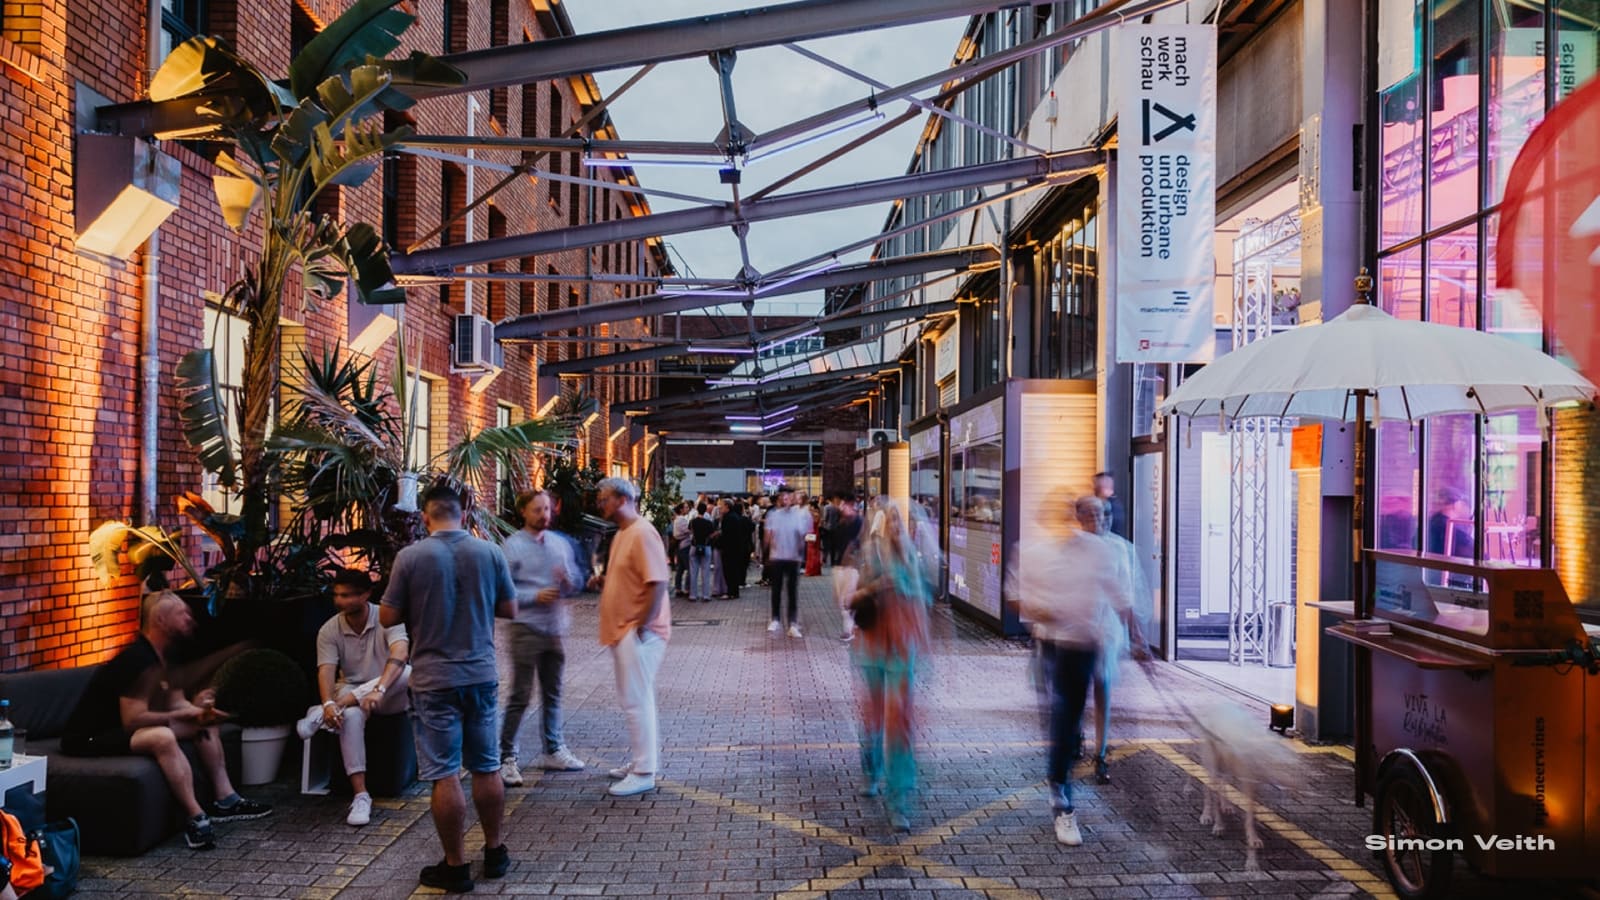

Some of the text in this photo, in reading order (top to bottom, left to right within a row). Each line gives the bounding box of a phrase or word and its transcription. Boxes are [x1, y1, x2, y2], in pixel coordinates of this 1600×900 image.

[1141, 36, 1155, 90] schau
[1158, 36, 1172, 81] werk
[1175, 37, 1190, 86] mach
[1139, 155, 1157, 257] produktion
[1159, 155, 1173, 260] und urbane
[1173, 155, 1191, 216] design
